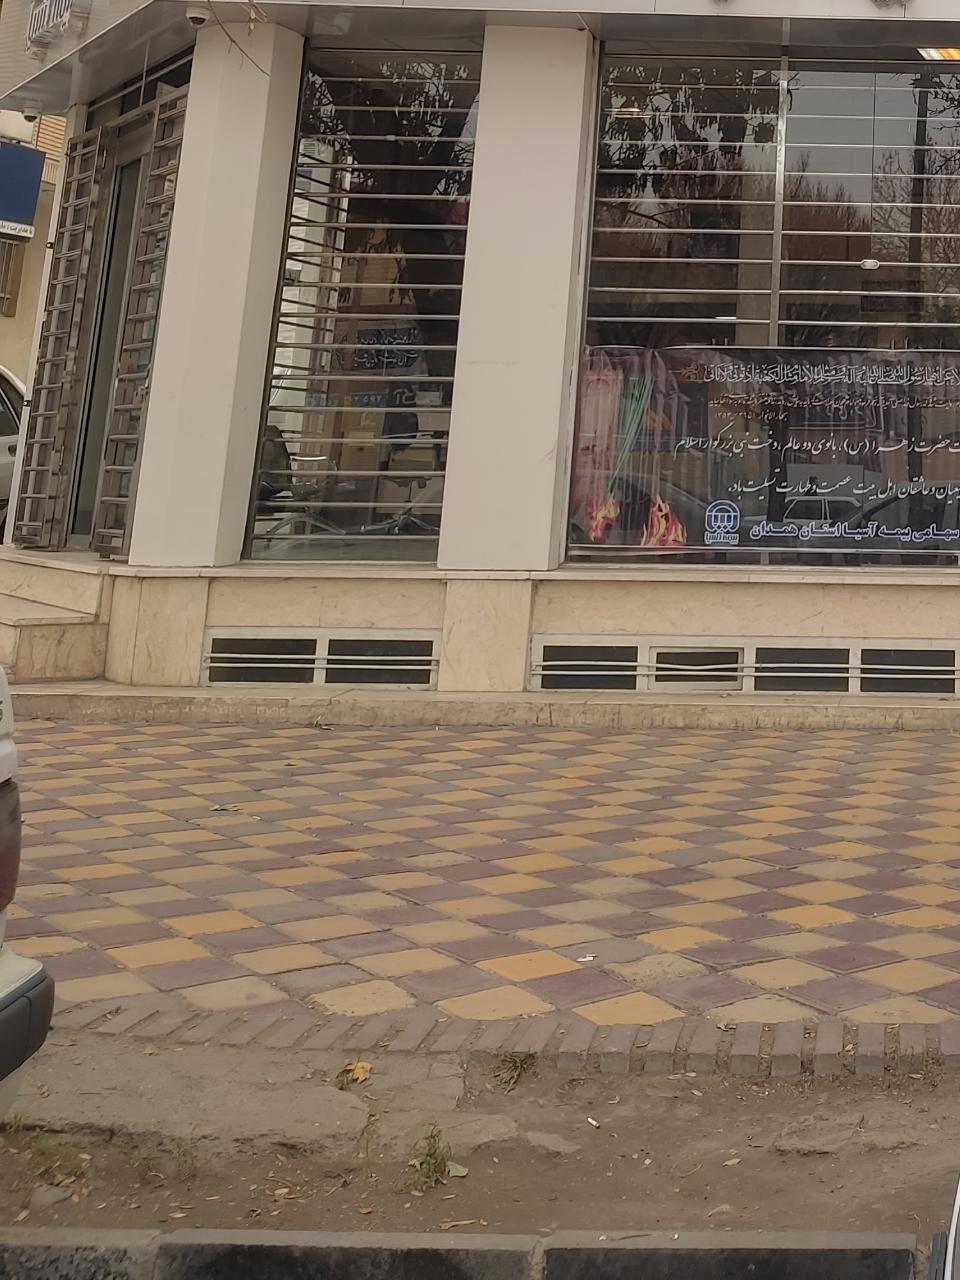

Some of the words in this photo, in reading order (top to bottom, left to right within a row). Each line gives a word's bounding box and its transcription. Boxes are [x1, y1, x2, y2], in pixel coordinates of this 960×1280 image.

[674, 436, 703, 460] اسلام
[915, 434, 951, 457] حضرت
[742, 468, 781, 500] تسلیت
[776, 480, 809, 494] طهارت
[816, 474, 853, 493] عصمت
[878, 477, 897, 499] اهل
[749, 520, 799, 539] همدان
[799, 521, 842, 540] استان
[842, 521, 878, 541] آسیا
[877, 525, 912, 541] بیمه
[911, 523, 960, 543] سهامی
